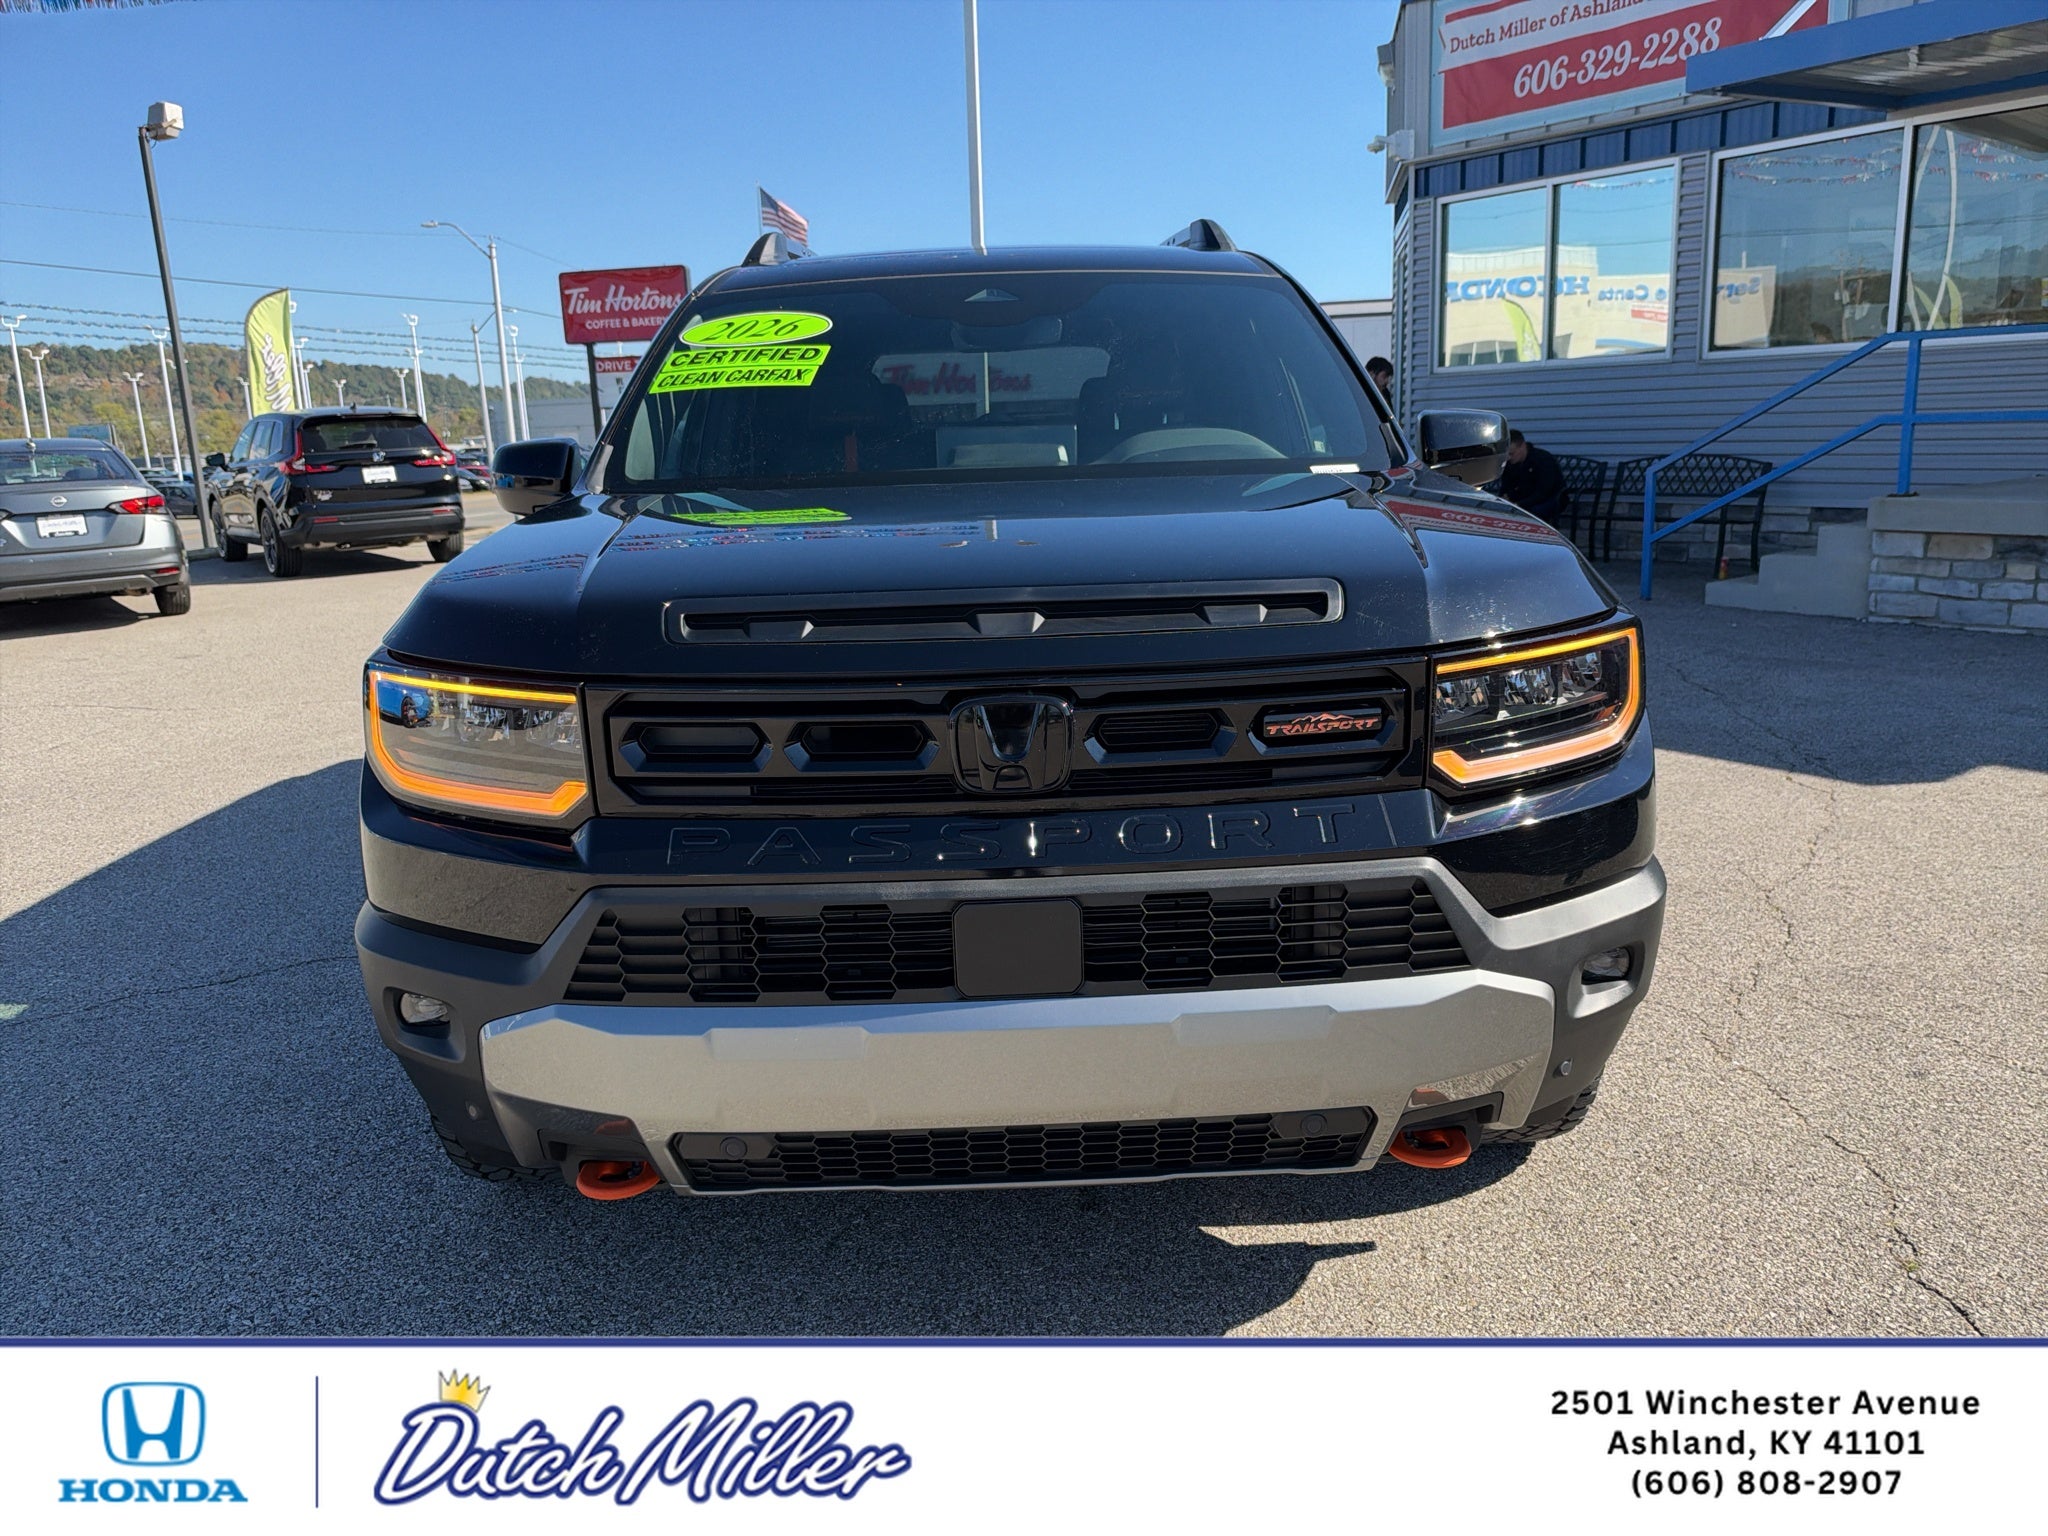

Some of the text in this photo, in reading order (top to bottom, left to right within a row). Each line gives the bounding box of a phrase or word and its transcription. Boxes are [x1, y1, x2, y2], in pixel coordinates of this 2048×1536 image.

[1449, 27, 1496, 54] Dutch
[1500, 13, 1547, 41] Miller
[1549, 6, 1568, 28] of
[1513, 16, 1722, 99] 606-329-2288
[564, 284, 682, 315] Tim Hortons
[585, 319, 621, 330] COFFEE
[623, 319, 629, 328] &
[700, 317, 808, 342] 2026
[596, 359, 632, 373] DRIVE
[669, 346, 823, 368] CERTIFIED
[657, 367, 810, 389] CLEAN CARFAX
[1266, 717, 1379, 736] TRAILSPORT
[666, 803, 1356, 866] PASSPORT
